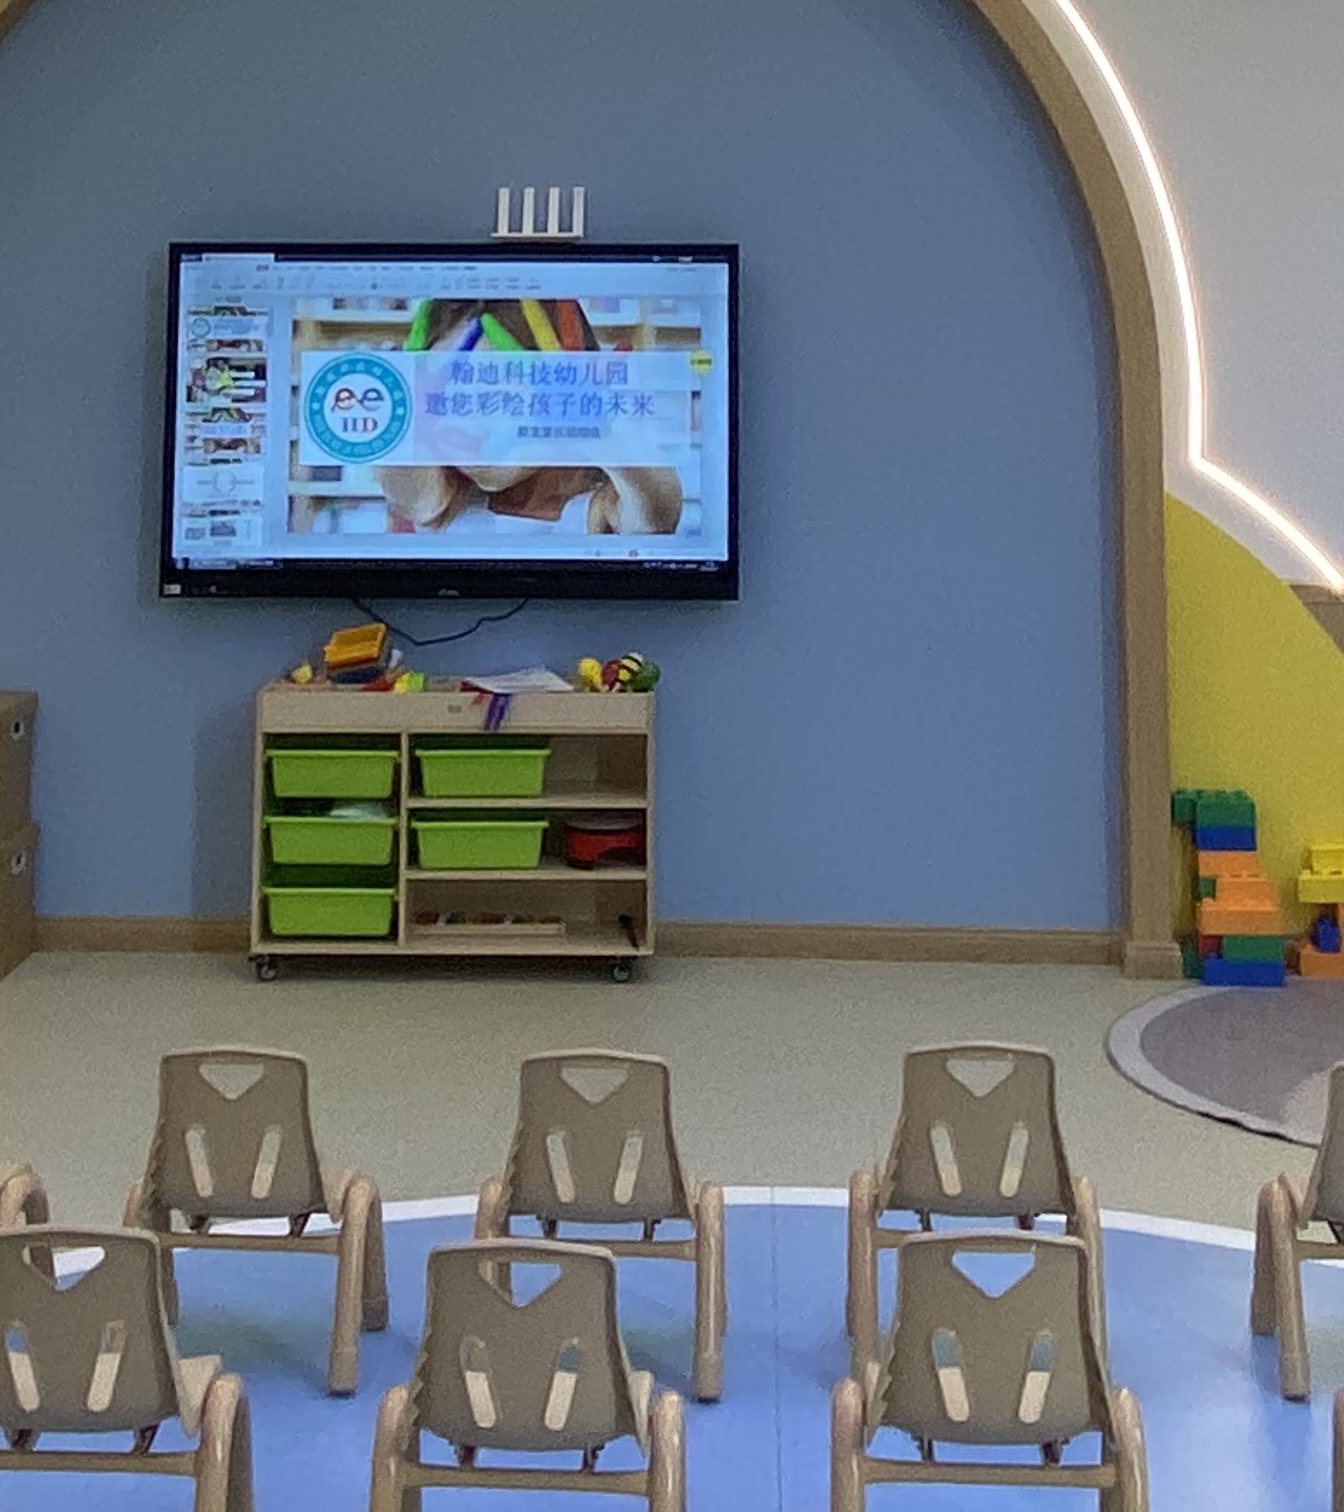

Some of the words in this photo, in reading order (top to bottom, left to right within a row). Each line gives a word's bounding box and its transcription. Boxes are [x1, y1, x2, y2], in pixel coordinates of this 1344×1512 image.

[424, 391, 656, 417] 邀您彩绘孩子的未来
